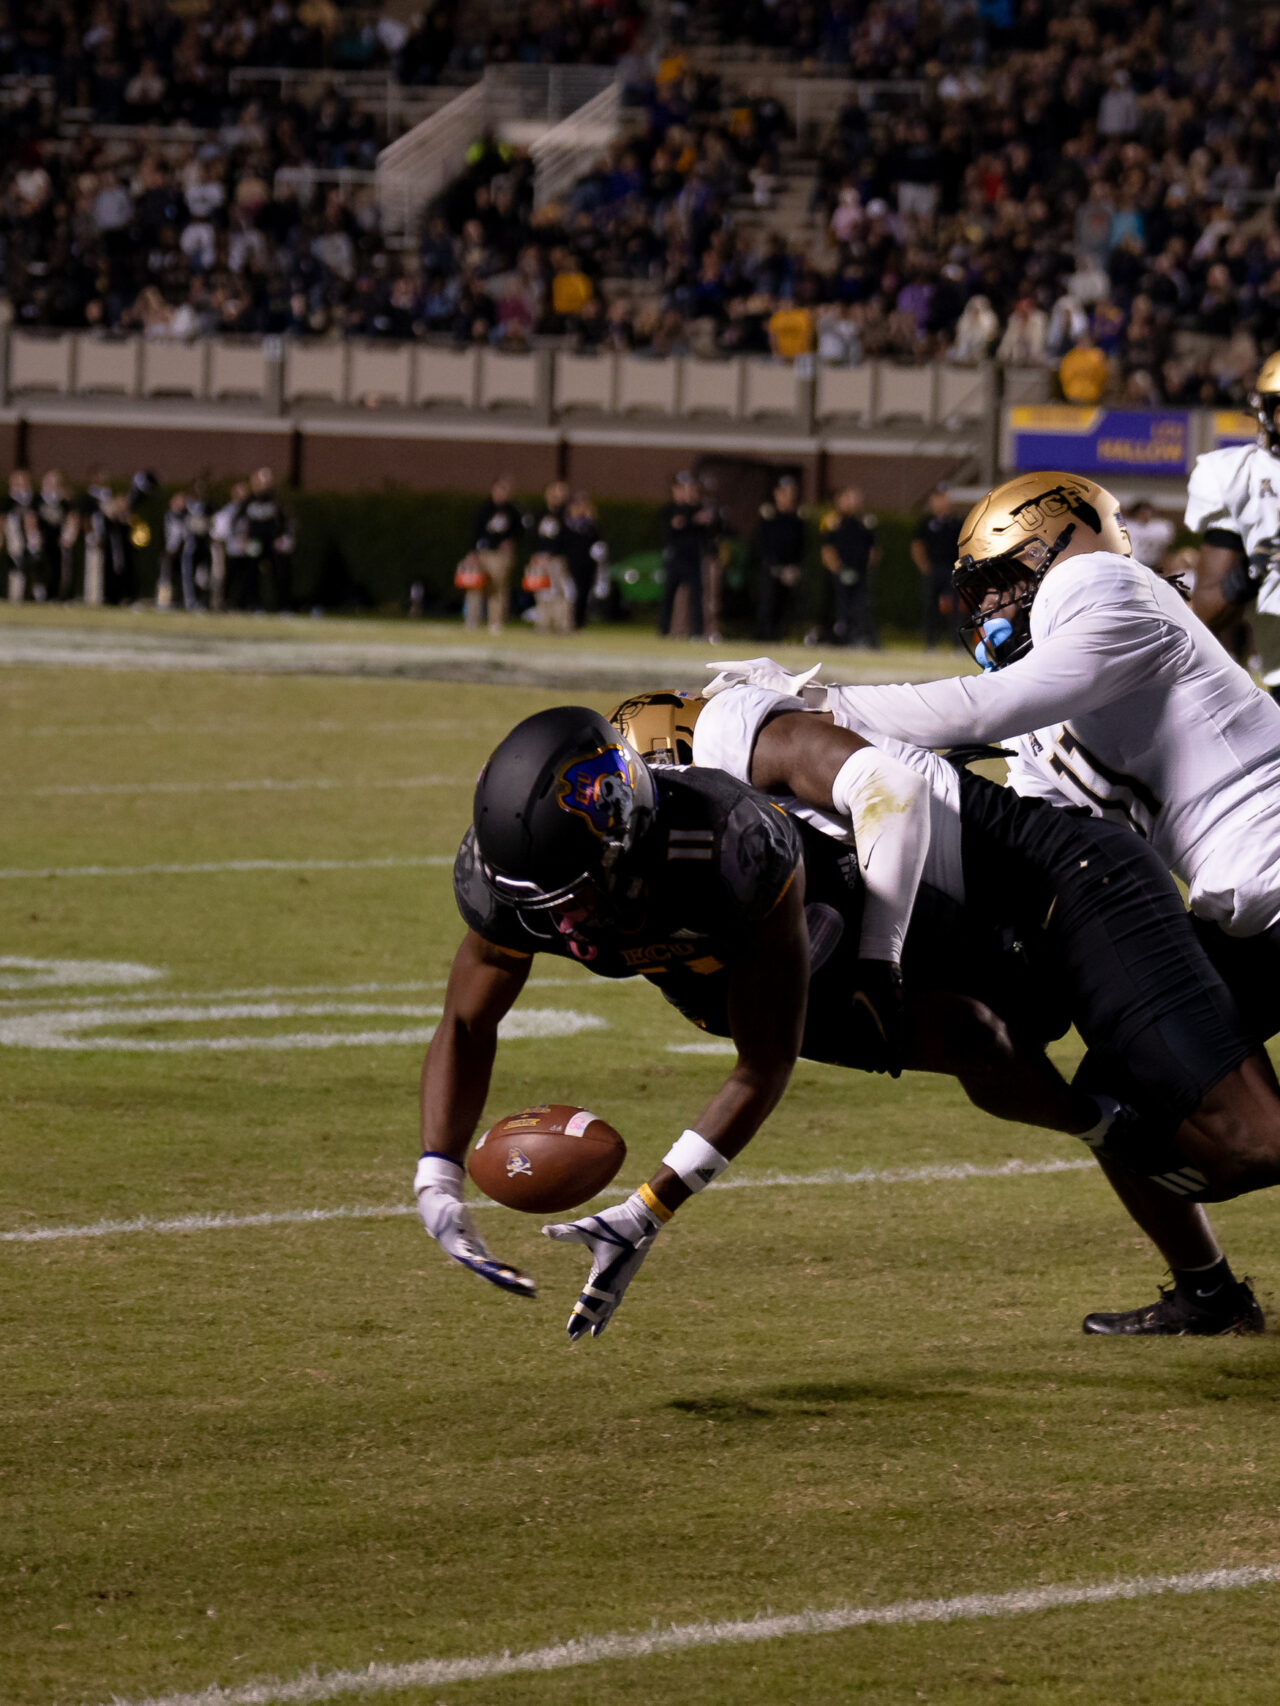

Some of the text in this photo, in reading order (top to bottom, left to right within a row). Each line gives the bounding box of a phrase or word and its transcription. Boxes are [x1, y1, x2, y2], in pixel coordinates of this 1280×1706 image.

[1012, 487, 1081, 532] UCF
[667, 829, 715, 861] 11
[619, 943, 695, 967] ECU
